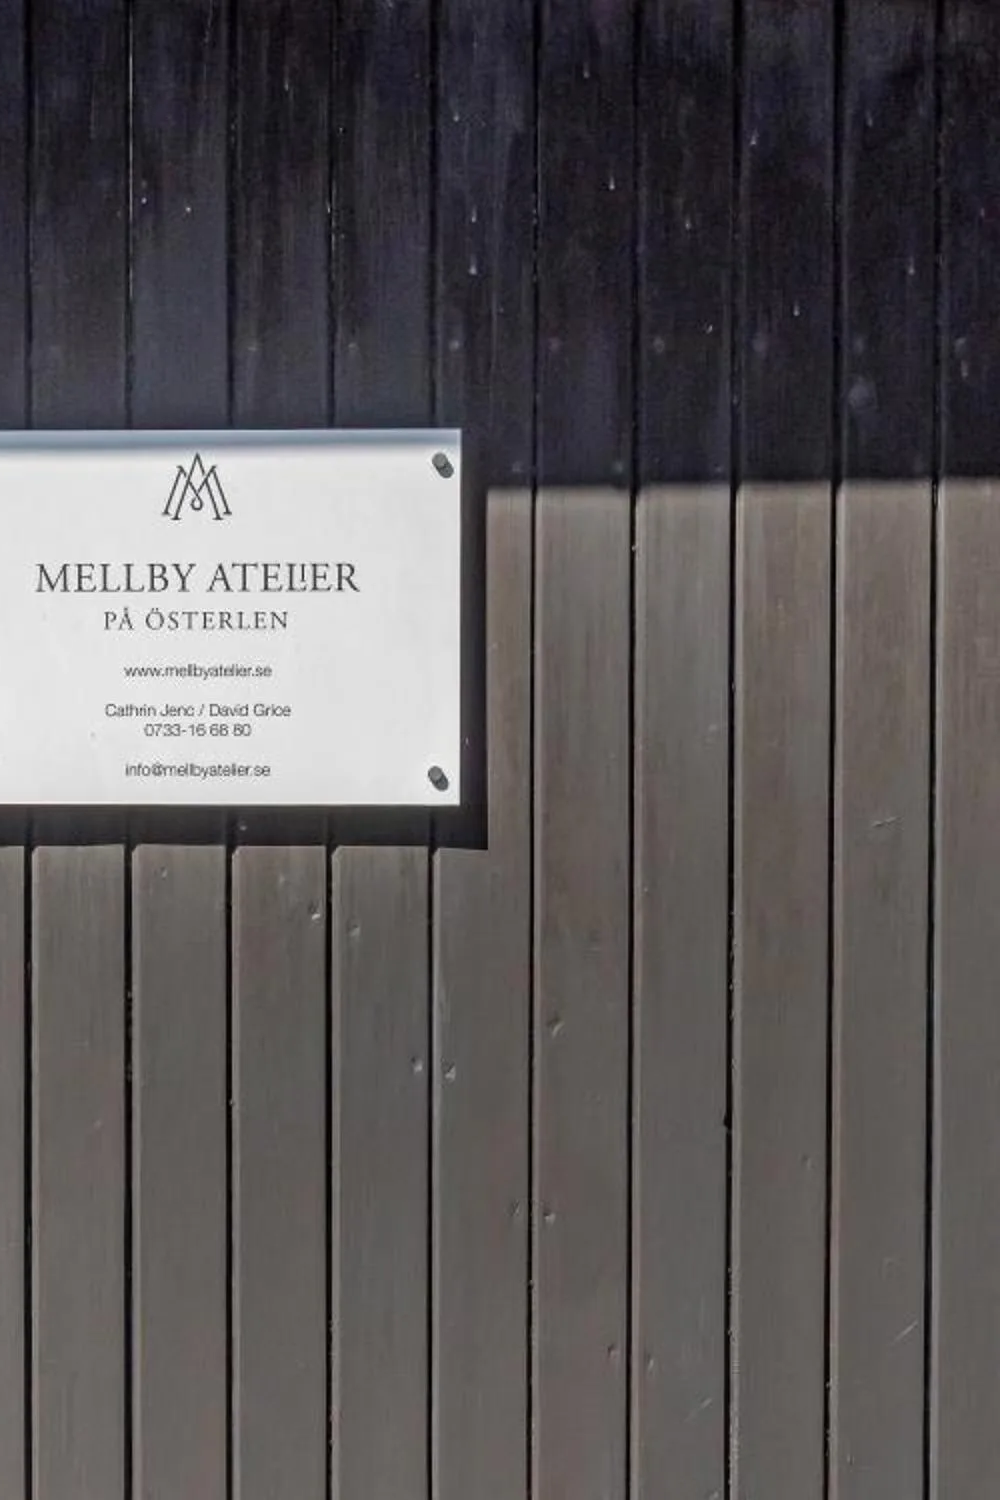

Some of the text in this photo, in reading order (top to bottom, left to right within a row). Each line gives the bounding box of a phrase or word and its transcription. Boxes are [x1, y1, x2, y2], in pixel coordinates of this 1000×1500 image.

[34, 562, 361, 593] MELLBY ATELIER
[103, 606, 289, 631] PÅ ÖSTERLEN
[123, 663, 273, 681] www.mellbyatelier.se
[105, 703, 157, 718] Cathrin
[208, 703, 250, 718] David
[143, 723, 207, 738] 0733-16
[124, 763, 273, 780] info@mellbyatelier.se
